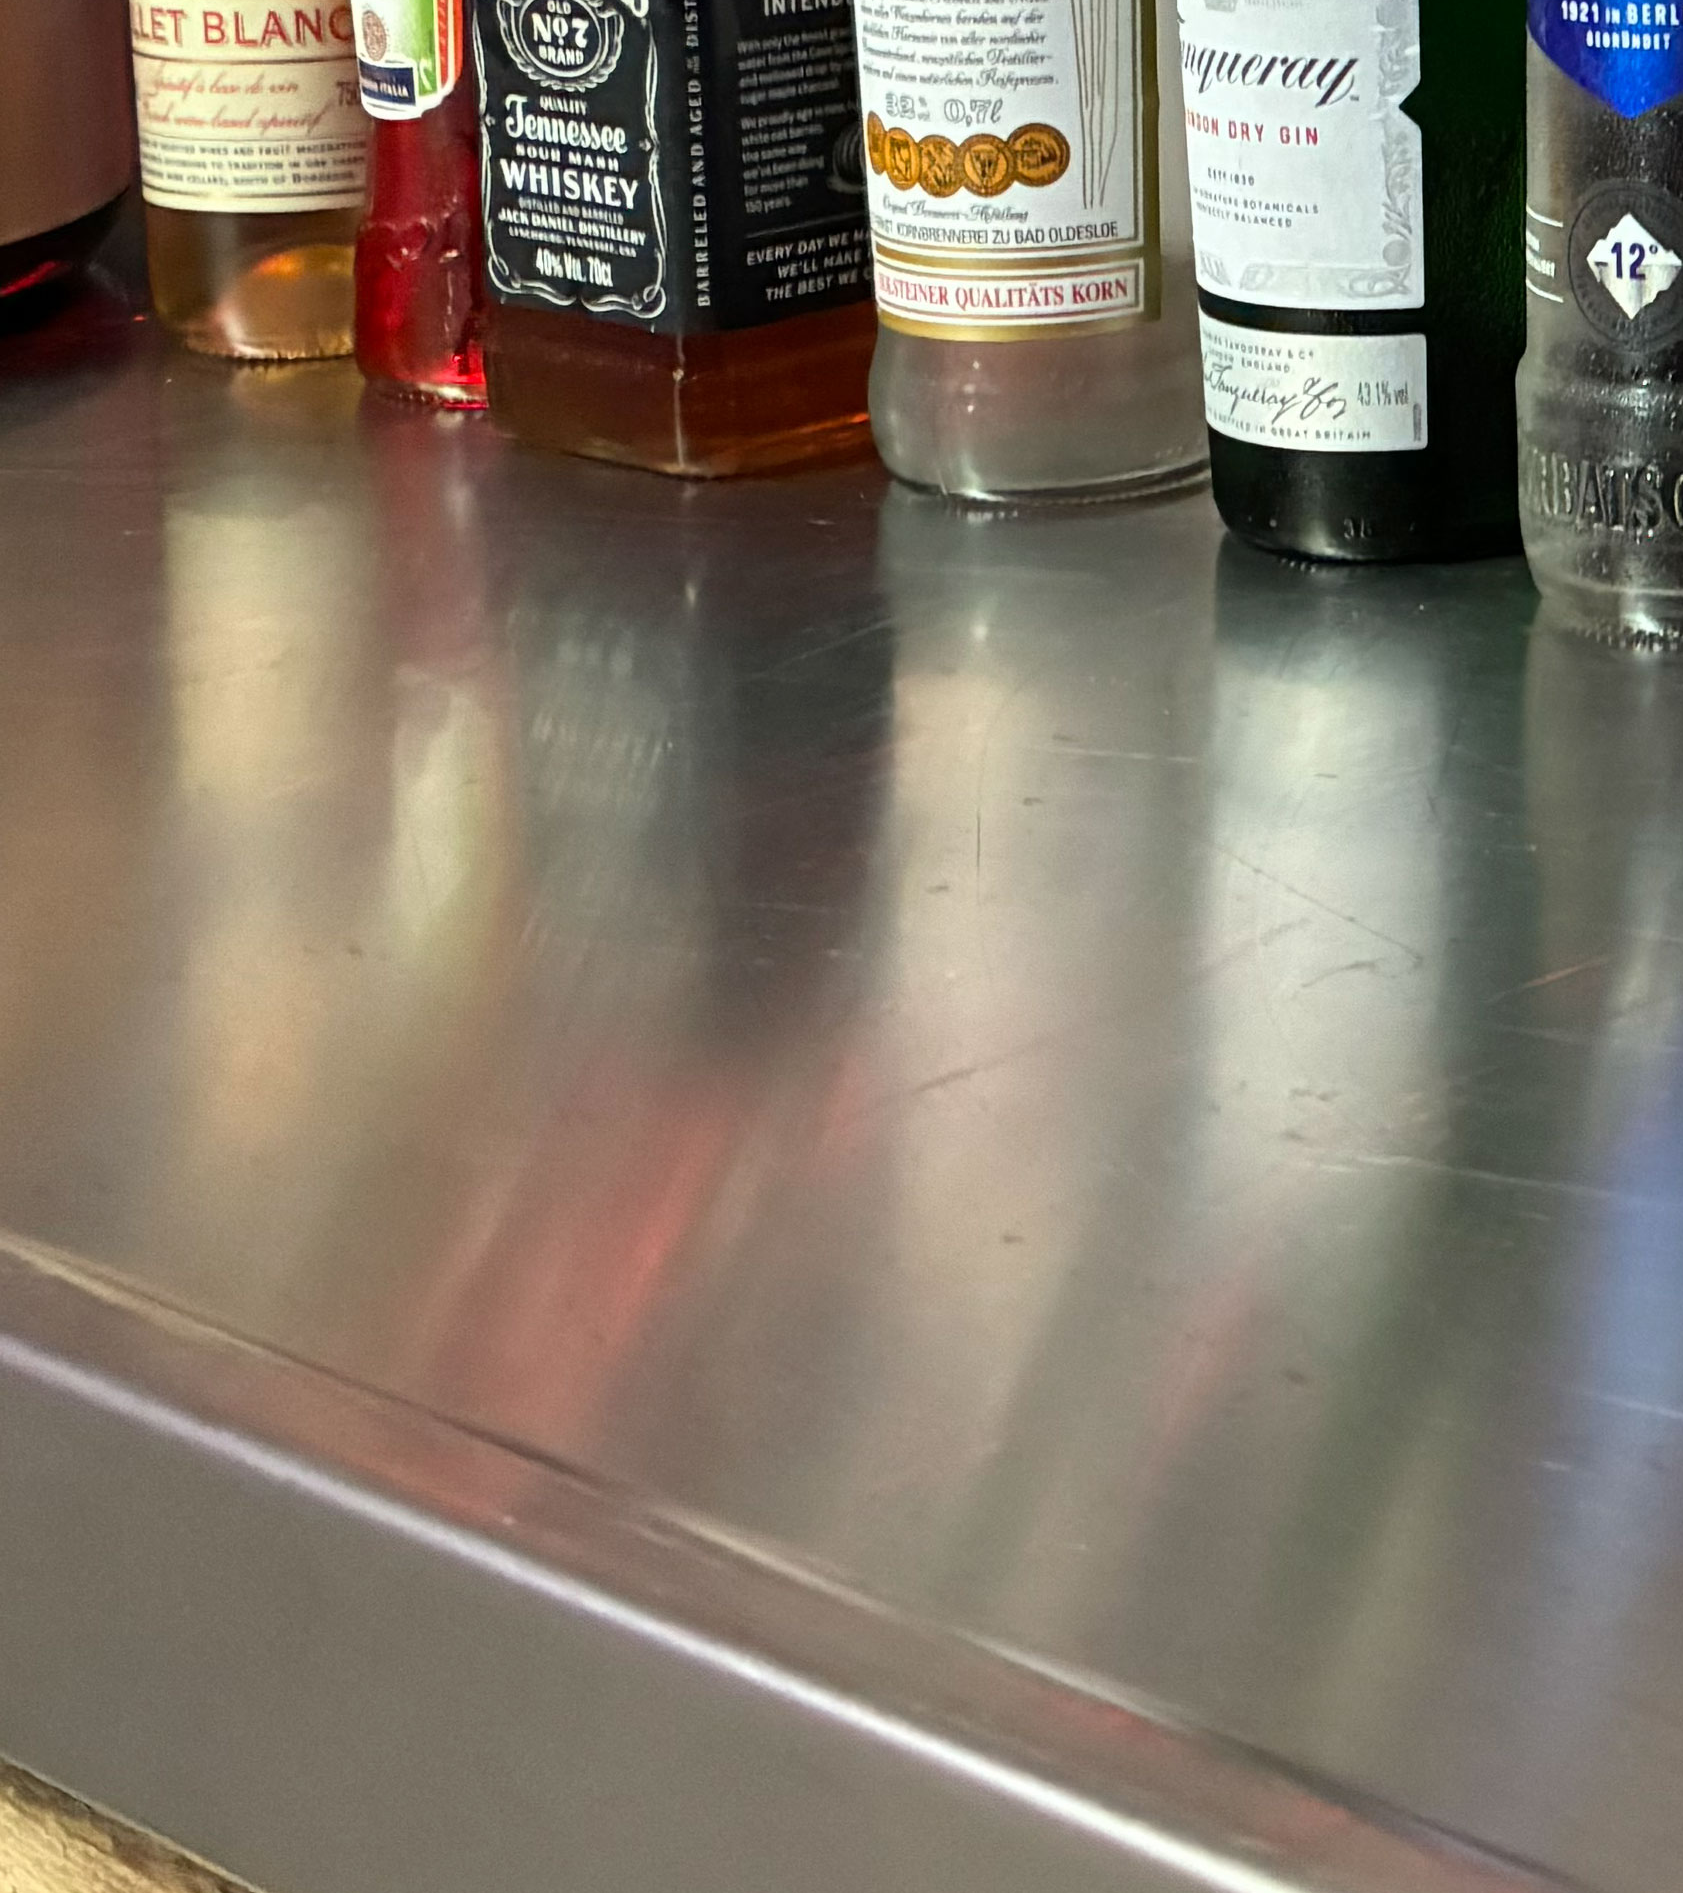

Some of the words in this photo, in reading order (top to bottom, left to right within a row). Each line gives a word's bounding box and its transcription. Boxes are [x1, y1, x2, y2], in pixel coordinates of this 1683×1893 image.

[546, 0, 572, 15] OLD
[1561, 0, 1599, 24] 1921
[538, 44, 585, 66] BRAND
[1182, 36, 1360, 109] nqueray
[504, 93, 629, 155] Tennessee
[1229, 119, 1265, 143] DRY
[1279, 125, 1319, 146] GIN
[690, 143, 707, 188] AND
[499, 158, 639, 210] WHISKEY
[991, 228, 1011, 245] ZU
[1013, 228, 1046, 245] BAD
[1048, 219, 1119, 243] OLDESLOE
[746, 243, 794, 266] EVERY
[797, 236, 825, 256] DAY
[828, 231, 850, 248] WE
[777, 257, 818, 280] WE'LL
[823, 248, 862, 269] MAKE
[765, 282, 794, 302] THE
[797, 273, 834, 296] BEST
[954, 281, 1065, 310] QUALITÄTS
[1071, 276, 1129, 305] KORN
